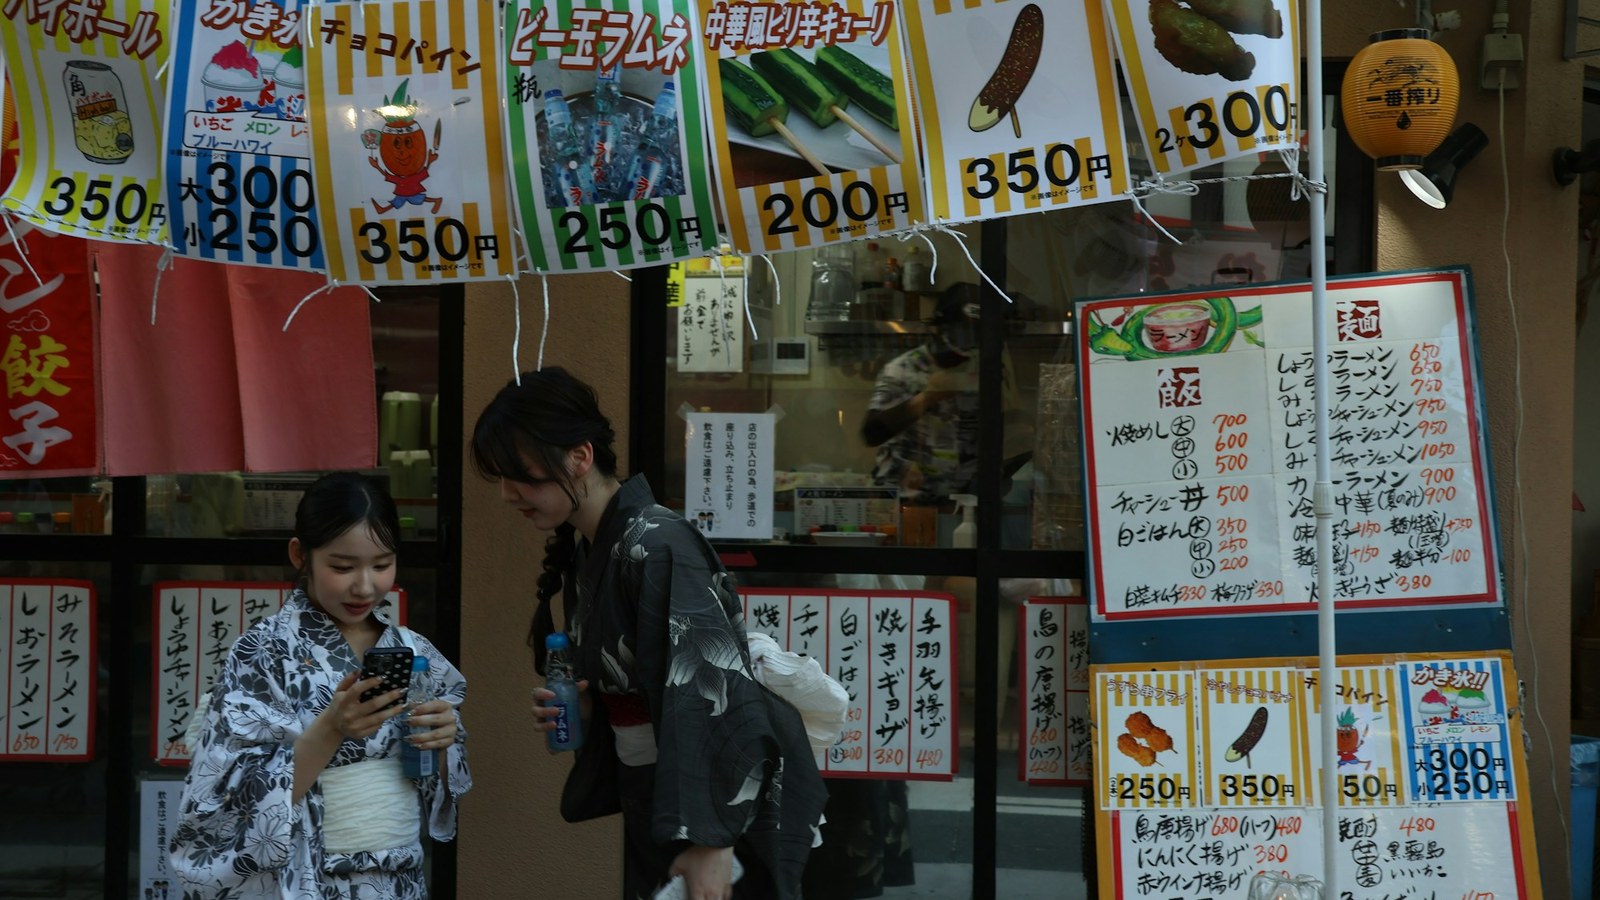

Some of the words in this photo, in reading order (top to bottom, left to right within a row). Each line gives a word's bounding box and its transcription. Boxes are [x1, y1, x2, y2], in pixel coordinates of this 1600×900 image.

[2, 0, 162, 59] ハイボール
[704, 1, 895, 51] 中華風ピリ辛キューリ
[320, 19, 481, 75] チョコパイン
[509, 7, 692, 74] ビー玉ラムネ
[1366, 87, 1441, 107] 一番搾り
[243, 121, 280, 136] メロン
[192, 134, 272, 153] ブルーハワイ
[966, 143, 1112, 200] 350円
[179, 177, 203, 203] 大
[206, 162, 314, 212] 300
[44, 177, 166, 227] 350円
[763, 180, 910, 236] 200円
[183, 222, 205, 247] 小
[210, 208, 317, 257] 250
[359, 218, 499, 264] 350円
[558, 203, 702, 254] 250円
[1150, 328, 1201, 343] ラーメン
[1410, 343, 1440, 362] 650
[1411, 361, 1442, 376] 650
[0, 334, 73, 466] 餃子
[1157, 366, 1202, 409] 飯
[1278, 382, 1400, 407] みラーメン
[1410, 379, 1443, 396] 750
[1415, 399, 1446, 416] 950
[1106, 421, 1169, 447] 焼めし
[1212, 413, 1247, 434] 700
[1215, 432, 1248, 452] 600
[1417, 420, 1448, 438] 950
[725, 423, 735, 510] 座り込み、立ち止まり
[1215, 453, 1248, 474] 500
[1285, 444, 1423, 470] みチャーシューメン
[1421, 443, 1456, 460] 1050
[1288, 470, 1409, 496] カーラーメン
[1420, 467, 1454, 485] 900
[1110, 482, 1209, 515] チャーシュー丼
[1216, 485, 1249, 506] 500
[1425, 486, 1456, 505] 900
[1118, 521, 1190, 547] 白ごはん
[1216, 517, 1247, 536] 350
[1217, 536, 1248, 553] 250
[1219, 555, 1249, 571] 200
[1179, 585, 1207, 601] 330
[1396, 575, 1431, 592] 380
[12, 592, 46, 730] しおラーメン
[53, 593, 82, 728] みそラーメン
[164, 596, 191, 742] しょうゆチャーシューメン
[914, 608, 946, 739] 手羽先揚げ
[1031, 608, 1062, 731] 鳥の唐揚げ
[876, 608, 908, 746] 焼きギョーザ
[1411, 666, 1489, 691] かき氷!!
[1305, 677, 1388, 706] チコパイン
[13, 732, 40, 752] 650
[874, 749, 904, 766] 380
[916, 749, 943, 769] 480
[1415, 758, 1429, 772] 大
[1429, 748, 1506, 772] 300円
[1119, 777, 1190, 800] 250円
[1222, 775, 1294, 797] 350円
[1338, 775, 1397, 797] 50円
[1418, 782, 1431, 796] 小
[1433, 771, 1509, 795] 250円
[1211, 815, 1238, 836] 680
[1240, 815, 1277, 840] (ハーフ)
[1275, 816, 1302, 836] 480
[1400, 817, 1435, 837] 480
[1137, 840, 1250, 868] にんにく揚げ
[1253, 844, 1288, 864] 380
